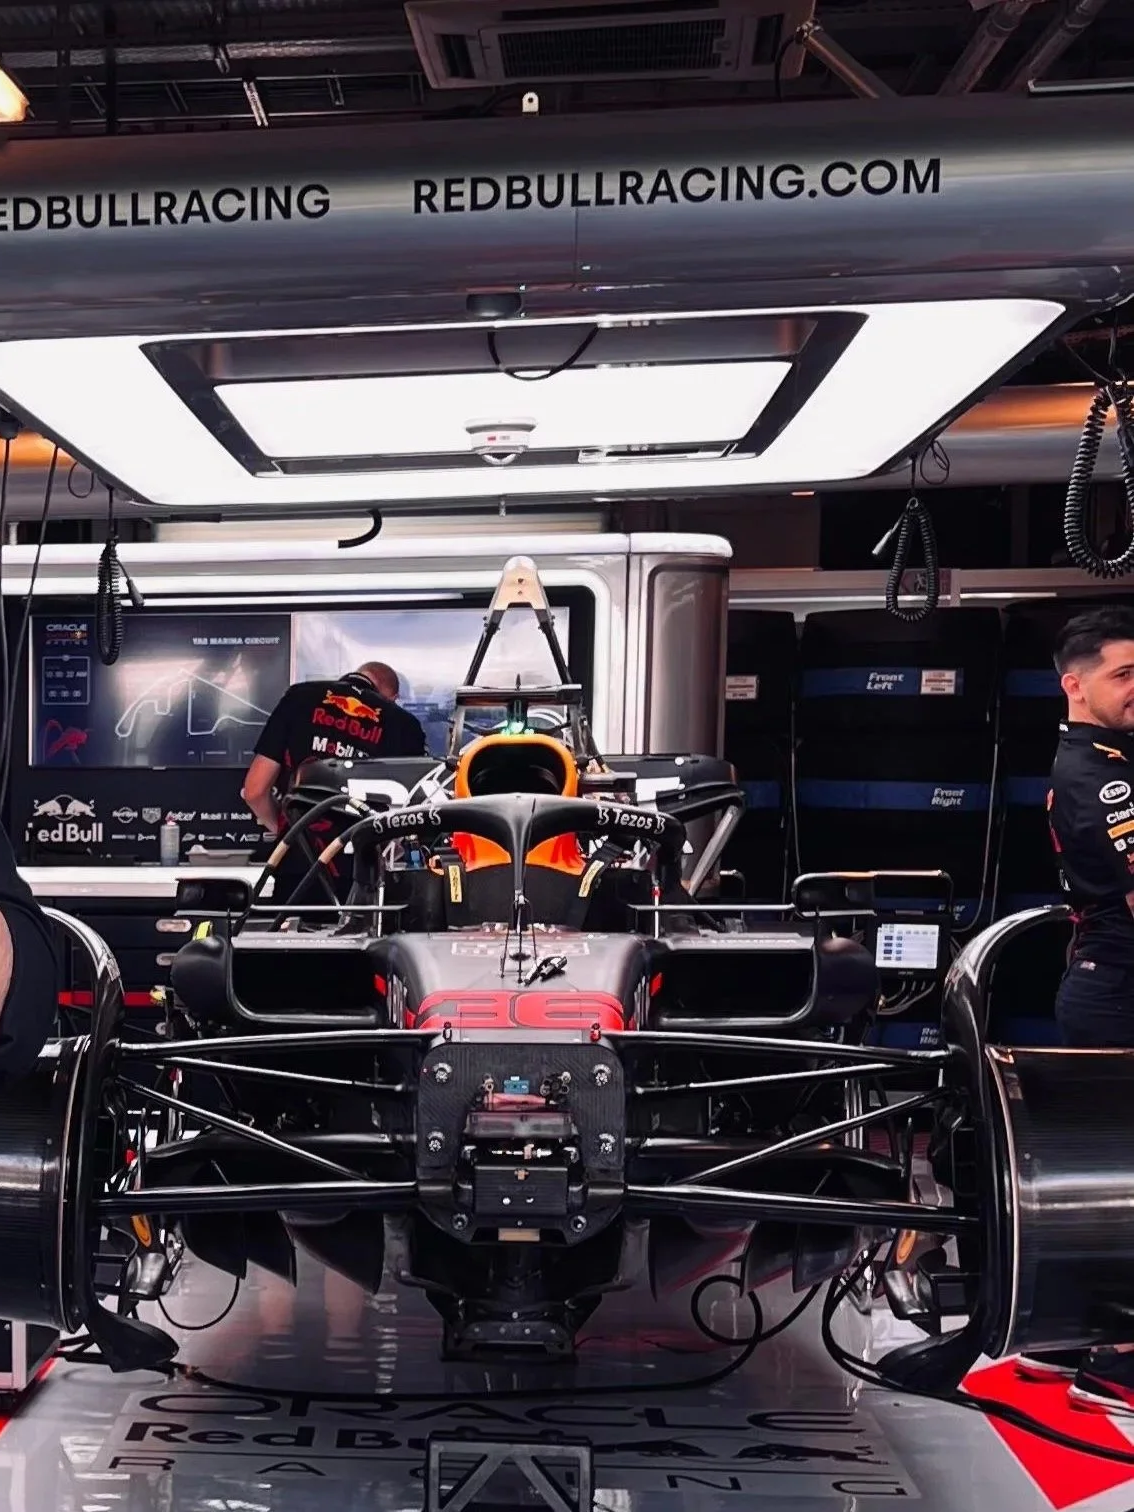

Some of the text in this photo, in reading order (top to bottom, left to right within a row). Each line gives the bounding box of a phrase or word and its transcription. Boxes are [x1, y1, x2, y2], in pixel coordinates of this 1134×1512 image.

[413, 158, 942, 214] REDBULLRACING.COM
[866, 682, 893, 691] Left
[868, 672, 905, 682] Front
[312, 736, 354, 758] Mobil
[613, 808, 653, 830] Tezos
[66, 822, 103, 842] Bull
[125, 1421, 316, 1447] Red
